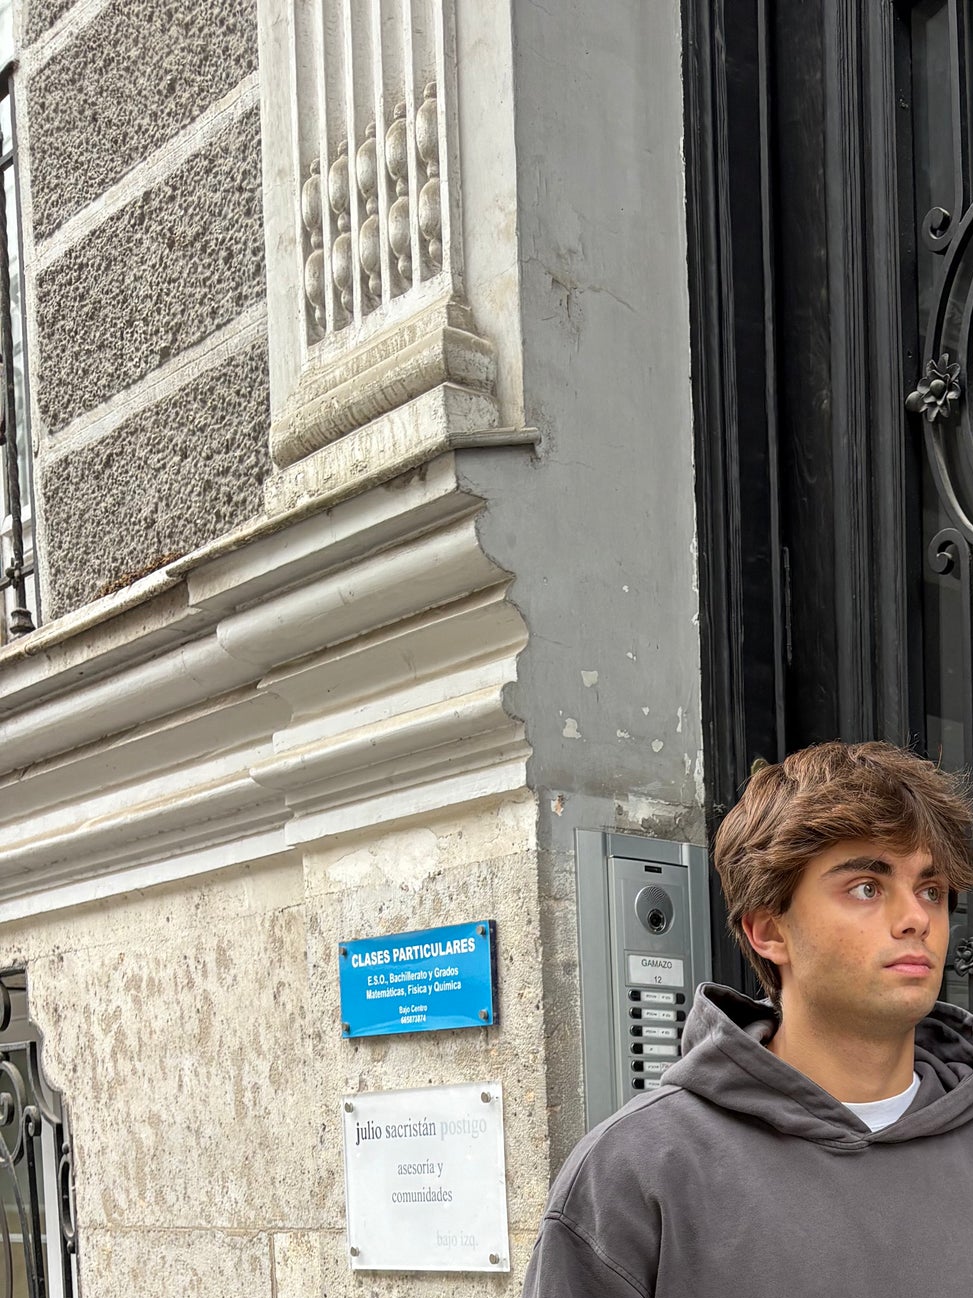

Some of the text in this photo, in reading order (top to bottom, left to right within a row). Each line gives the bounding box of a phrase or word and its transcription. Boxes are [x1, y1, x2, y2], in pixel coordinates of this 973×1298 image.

[351, 938, 476, 968] CLASES PARTICULARES
[641, 958, 673, 969] GAMAZO
[389, 970, 427, 984] Bachillerato
[428, 970, 433, 980] y
[434, 966, 459, 978] Grados
[654, 975, 663, 984] 12
[428, 984, 433, 995] y
[355, 1114, 487, 1146] julio sacristán postigo
[397, 1158, 444, 1178] asesoría y
[391, 1186, 453, 1203] comunidades
[437, 1230, 458, 1250] bajo
